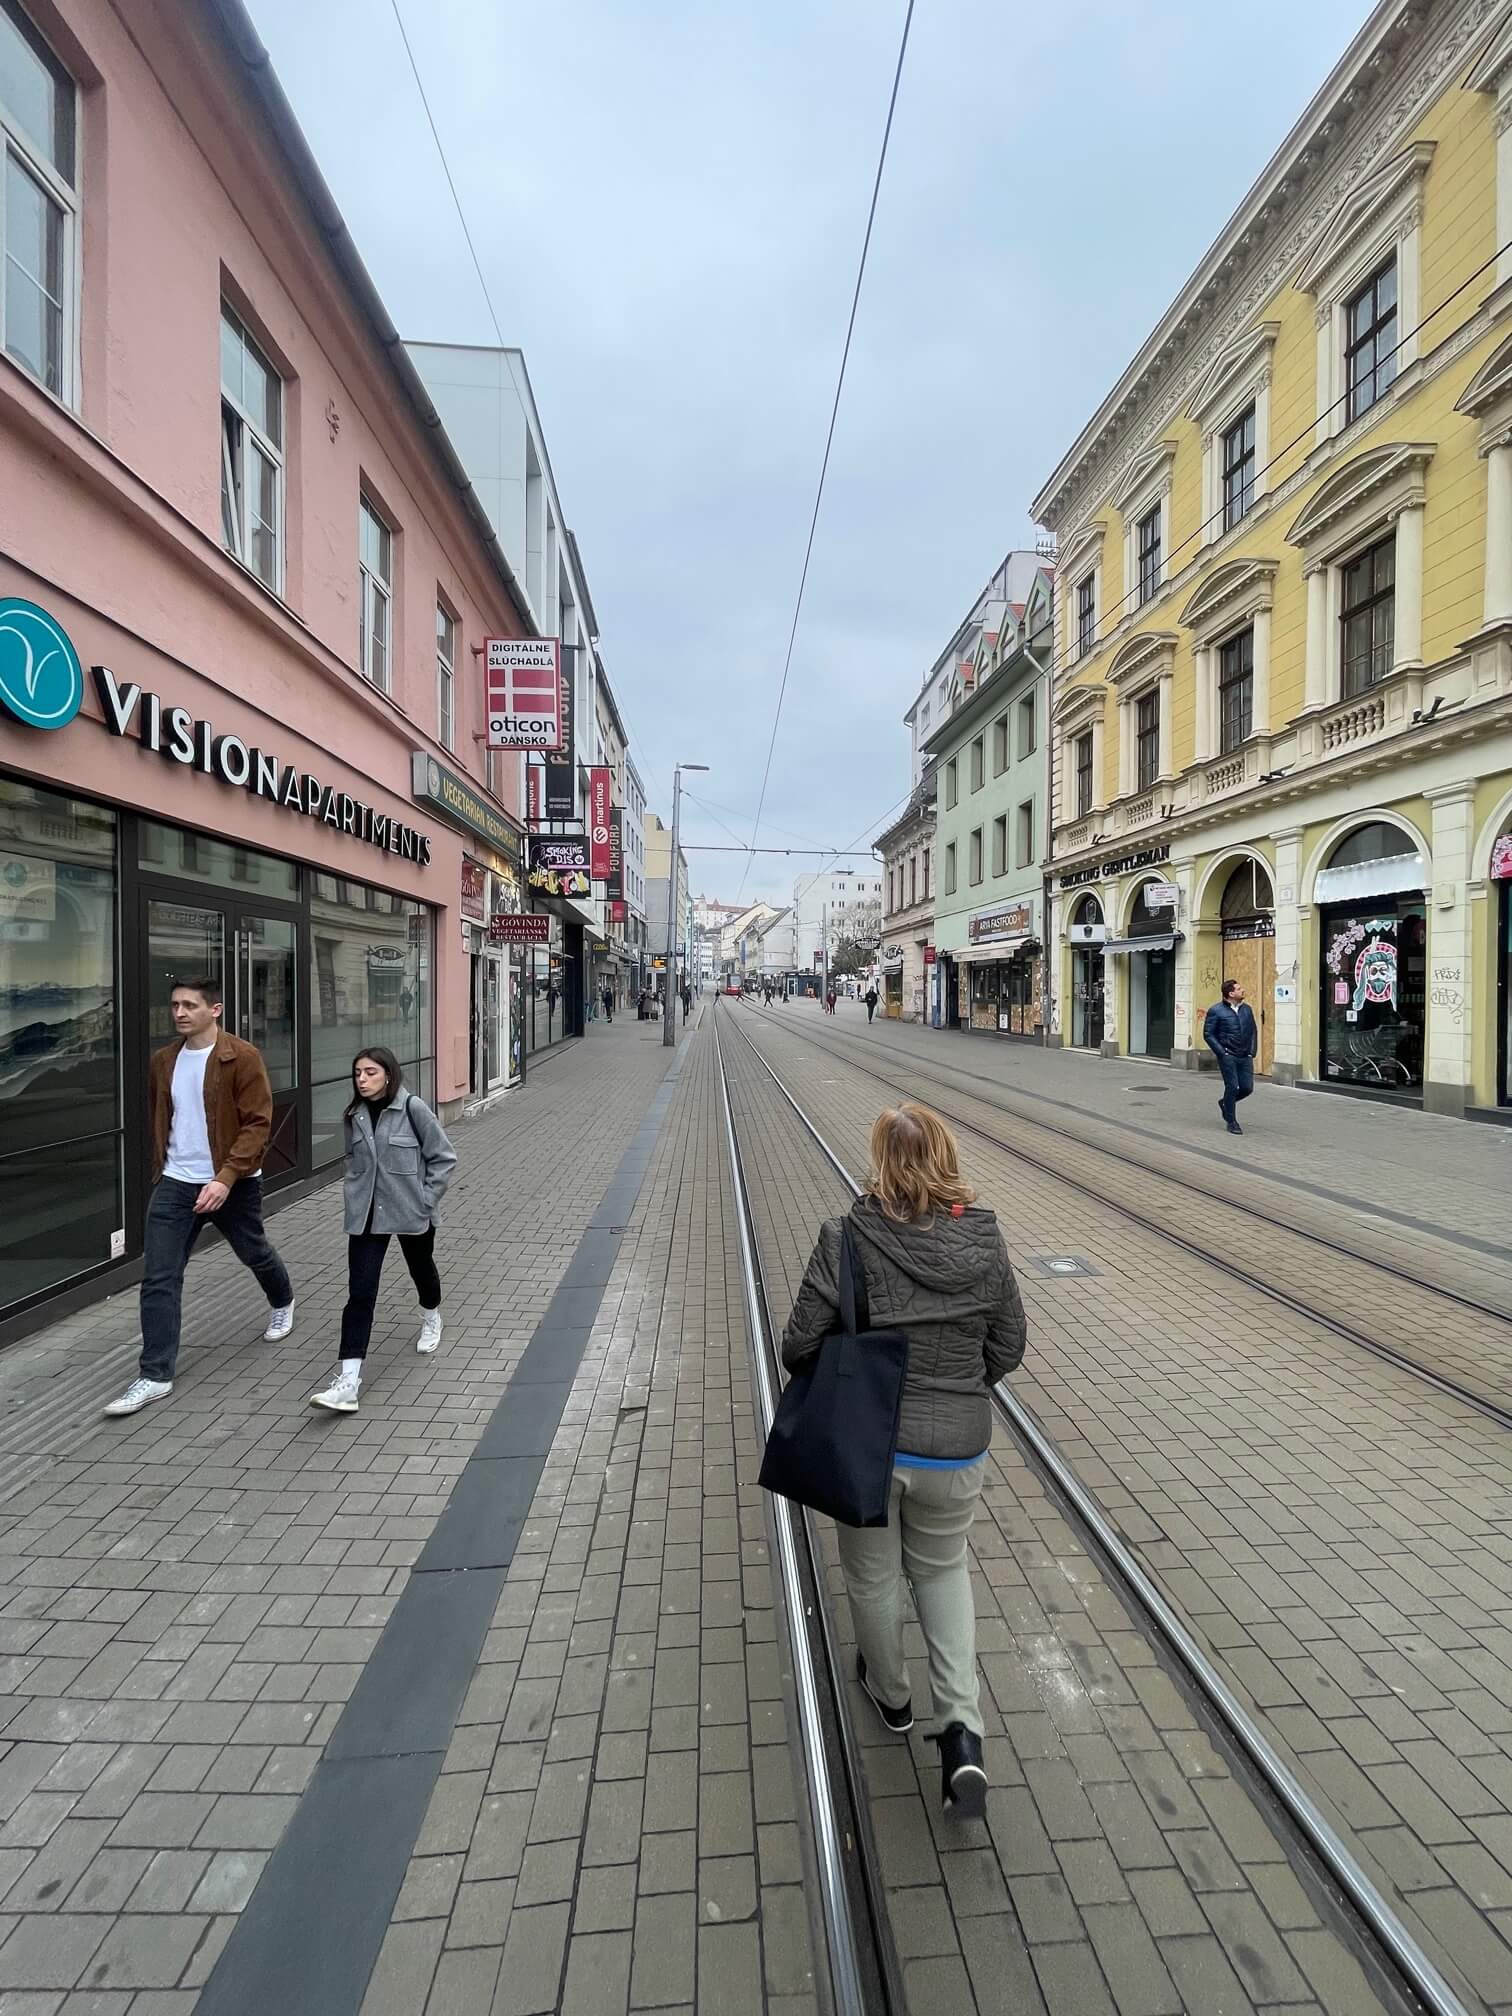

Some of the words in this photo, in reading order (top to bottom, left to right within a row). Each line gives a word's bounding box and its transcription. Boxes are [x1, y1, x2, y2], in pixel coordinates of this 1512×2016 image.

[492, 643, 550, 652] DIGITÁLNE
[490, 716, 556, 733] oticon
[92, 666, 433, 866] VISIONAPARTMENTS
[443, 776, 485, 828] VEGETARIAN
[595, 782, 604, 825] martinus
[1059, 865, 1100, 889] SMOKING
